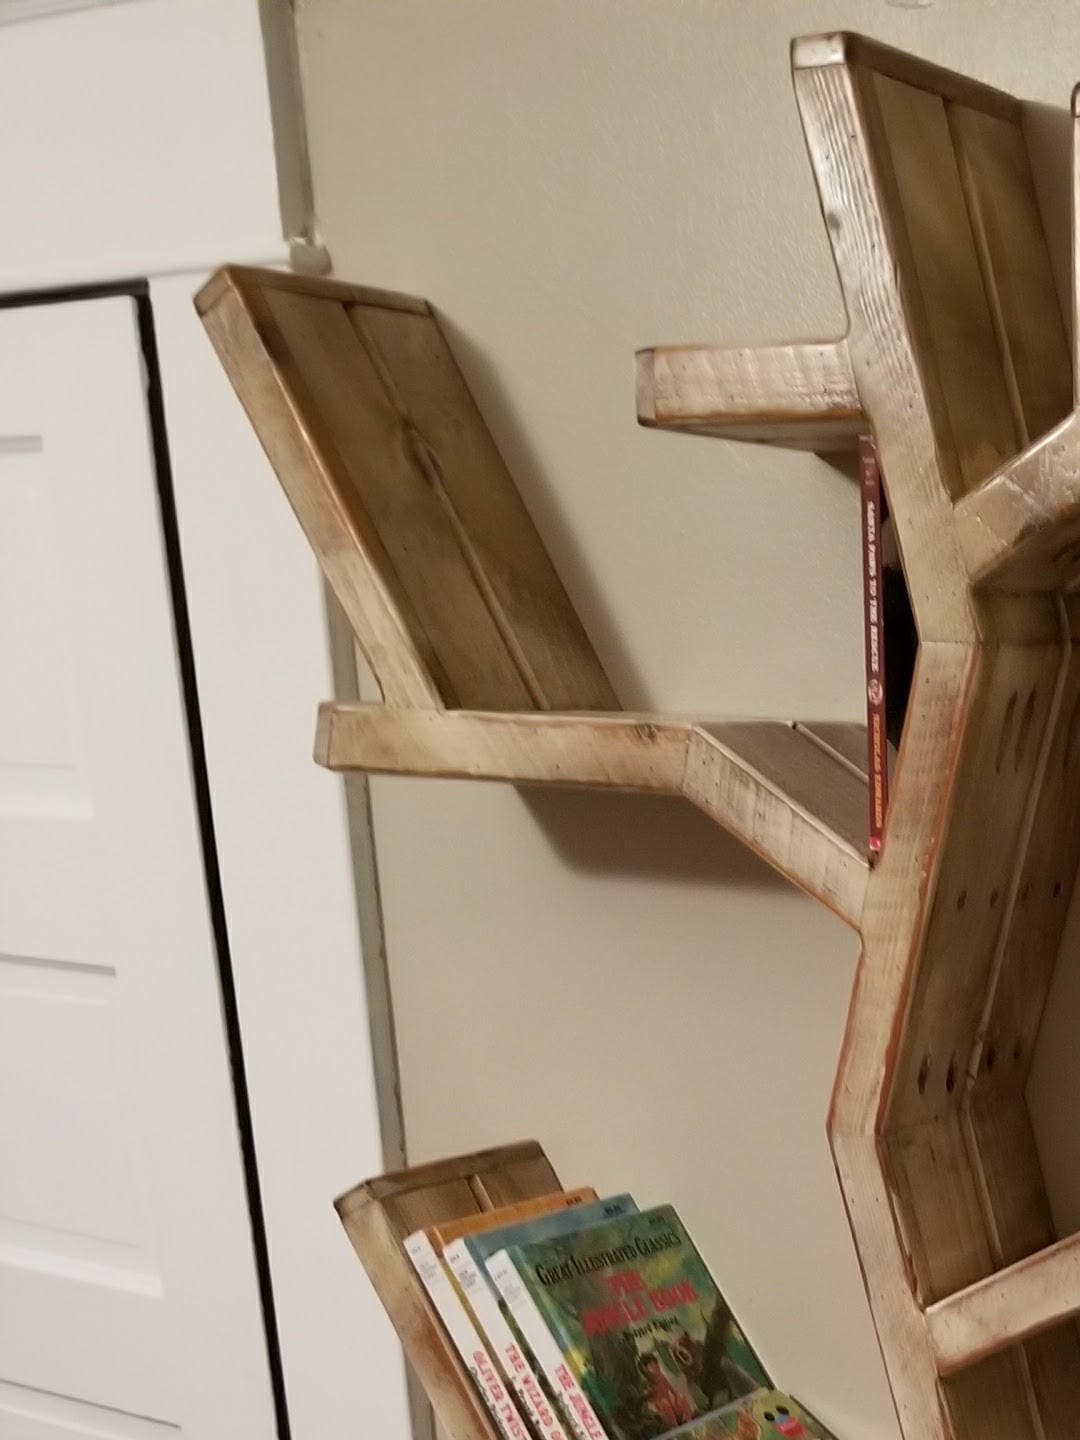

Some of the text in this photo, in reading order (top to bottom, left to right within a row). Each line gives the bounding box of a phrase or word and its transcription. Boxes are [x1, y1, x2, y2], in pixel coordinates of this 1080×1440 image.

[535, 1262, 573, 1286] GREAT
[635, 1231, 682, 1259] CLASSICS
[473, 1351, 504, 1402] OLIVER
[506, 1342, 525, 1373] THE
[522, 1374, 553, 1428] WIZARD
[555, 1363, 575, 1392] THE
